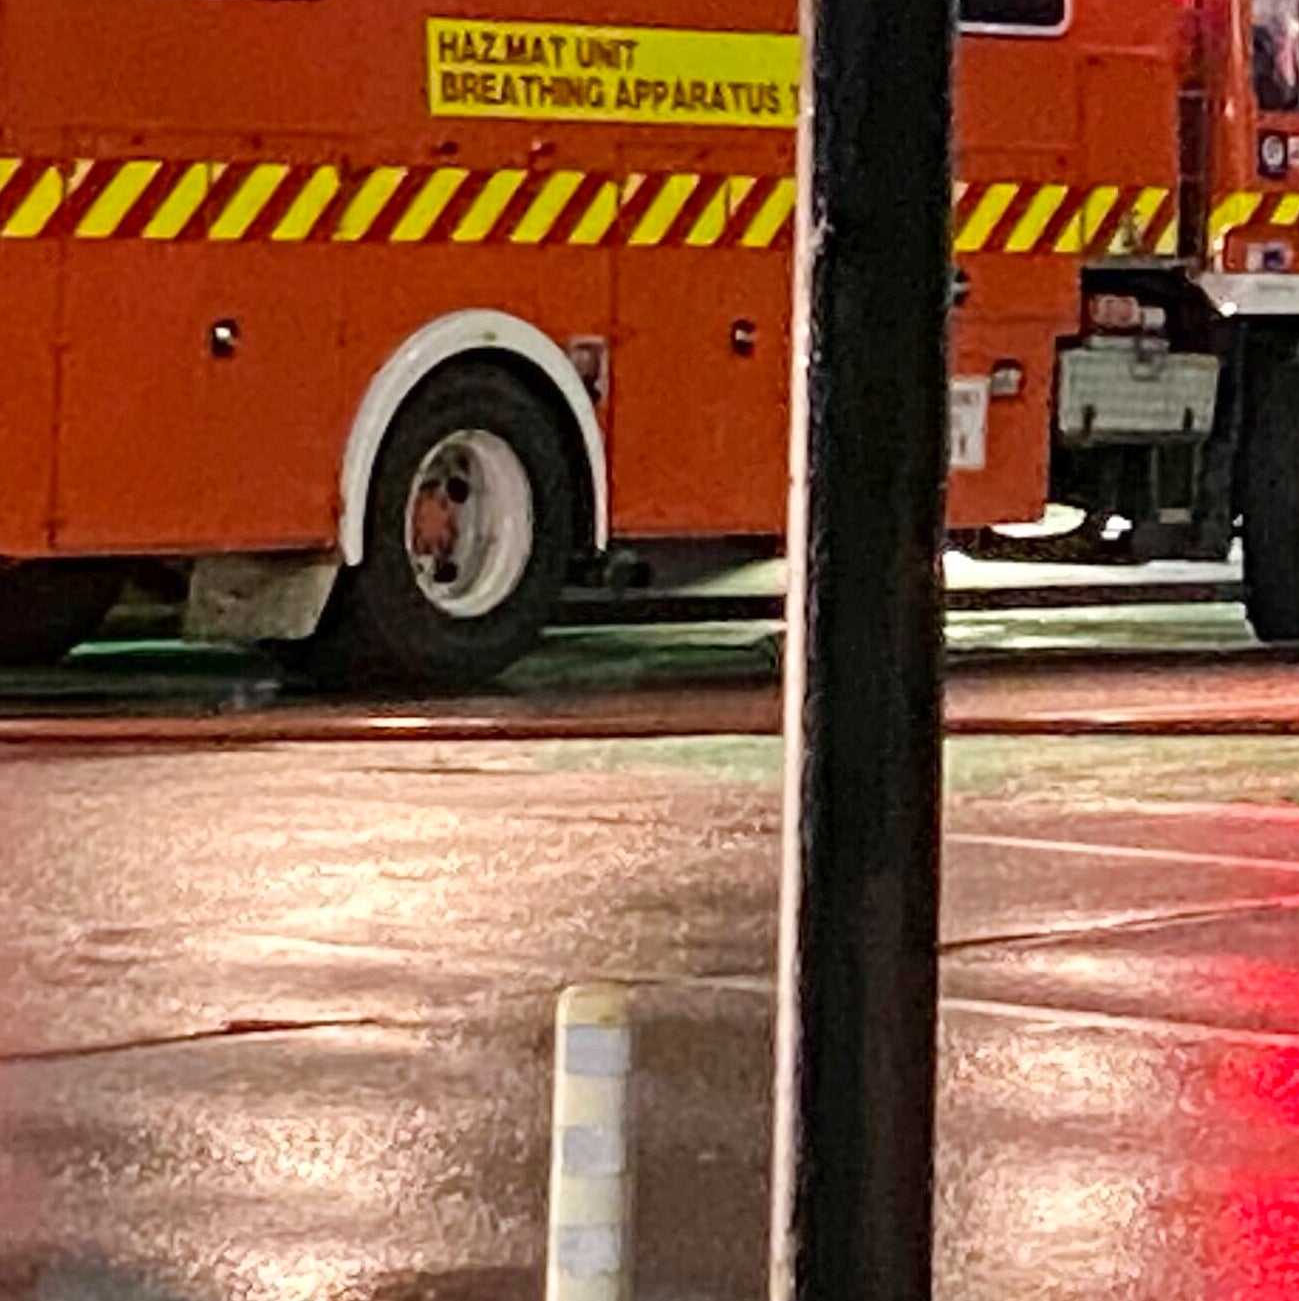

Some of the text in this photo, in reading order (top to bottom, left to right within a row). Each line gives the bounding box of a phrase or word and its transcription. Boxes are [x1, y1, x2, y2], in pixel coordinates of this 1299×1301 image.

[575, 37, 640, 71] UNIT
[438, 69, 604, 108] BREATHING
[614, 75, 780, 117] APPARATUS
